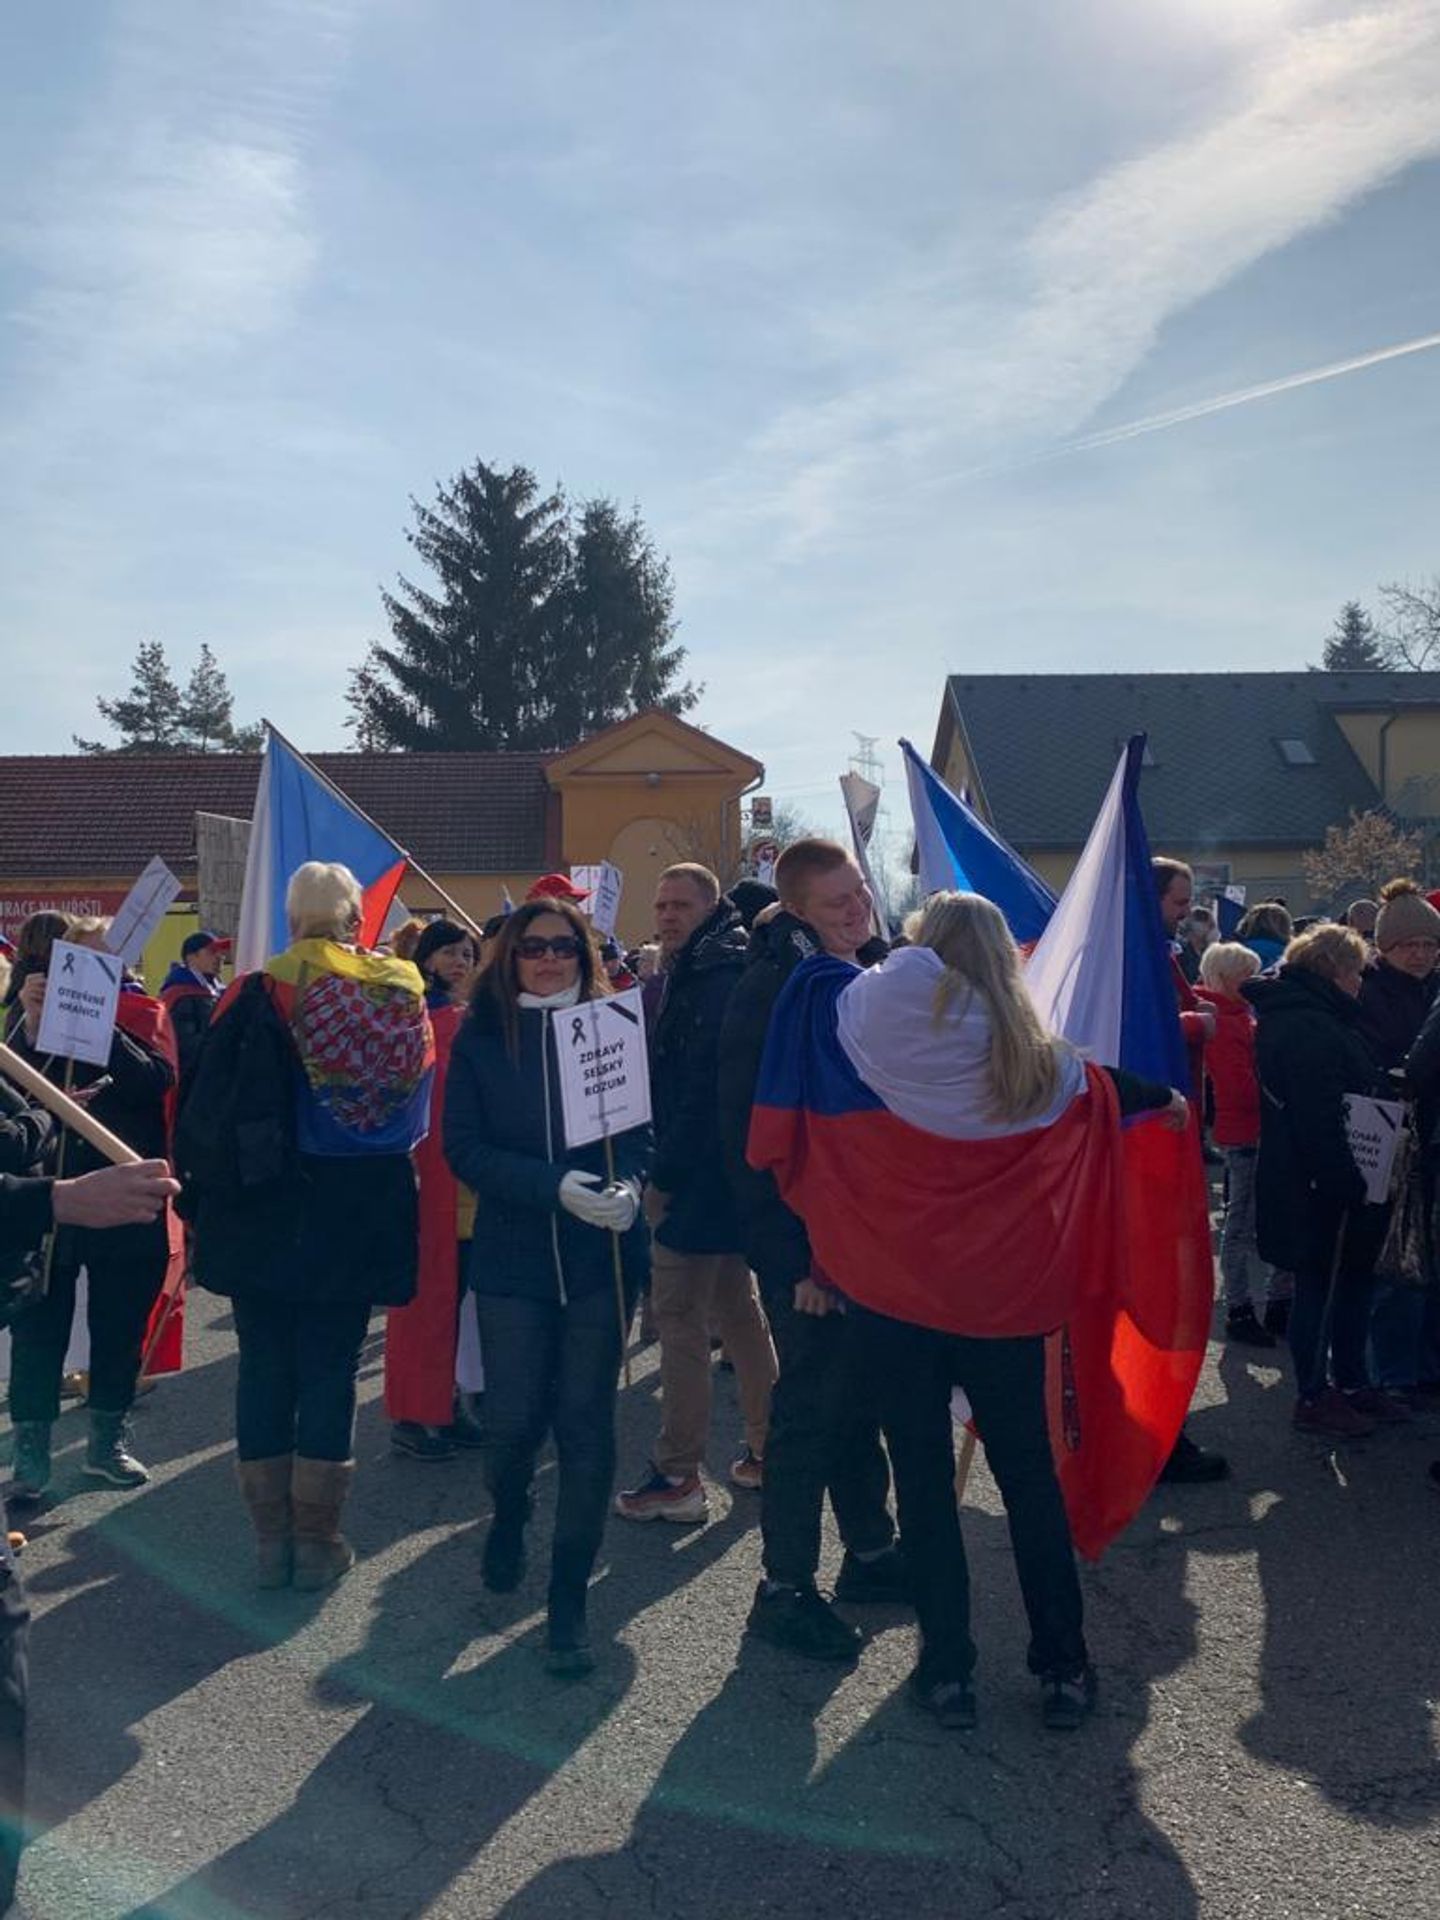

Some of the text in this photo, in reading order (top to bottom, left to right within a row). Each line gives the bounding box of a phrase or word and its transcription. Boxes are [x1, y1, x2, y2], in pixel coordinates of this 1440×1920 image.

[0, 900, 36, 917] RACE
[579, 1037, 625, 1064] ZDRAVÝ
[583, 1059, 624, 1081] SELSKÝ
[584, 1075, 627, 1097] ROZUM
